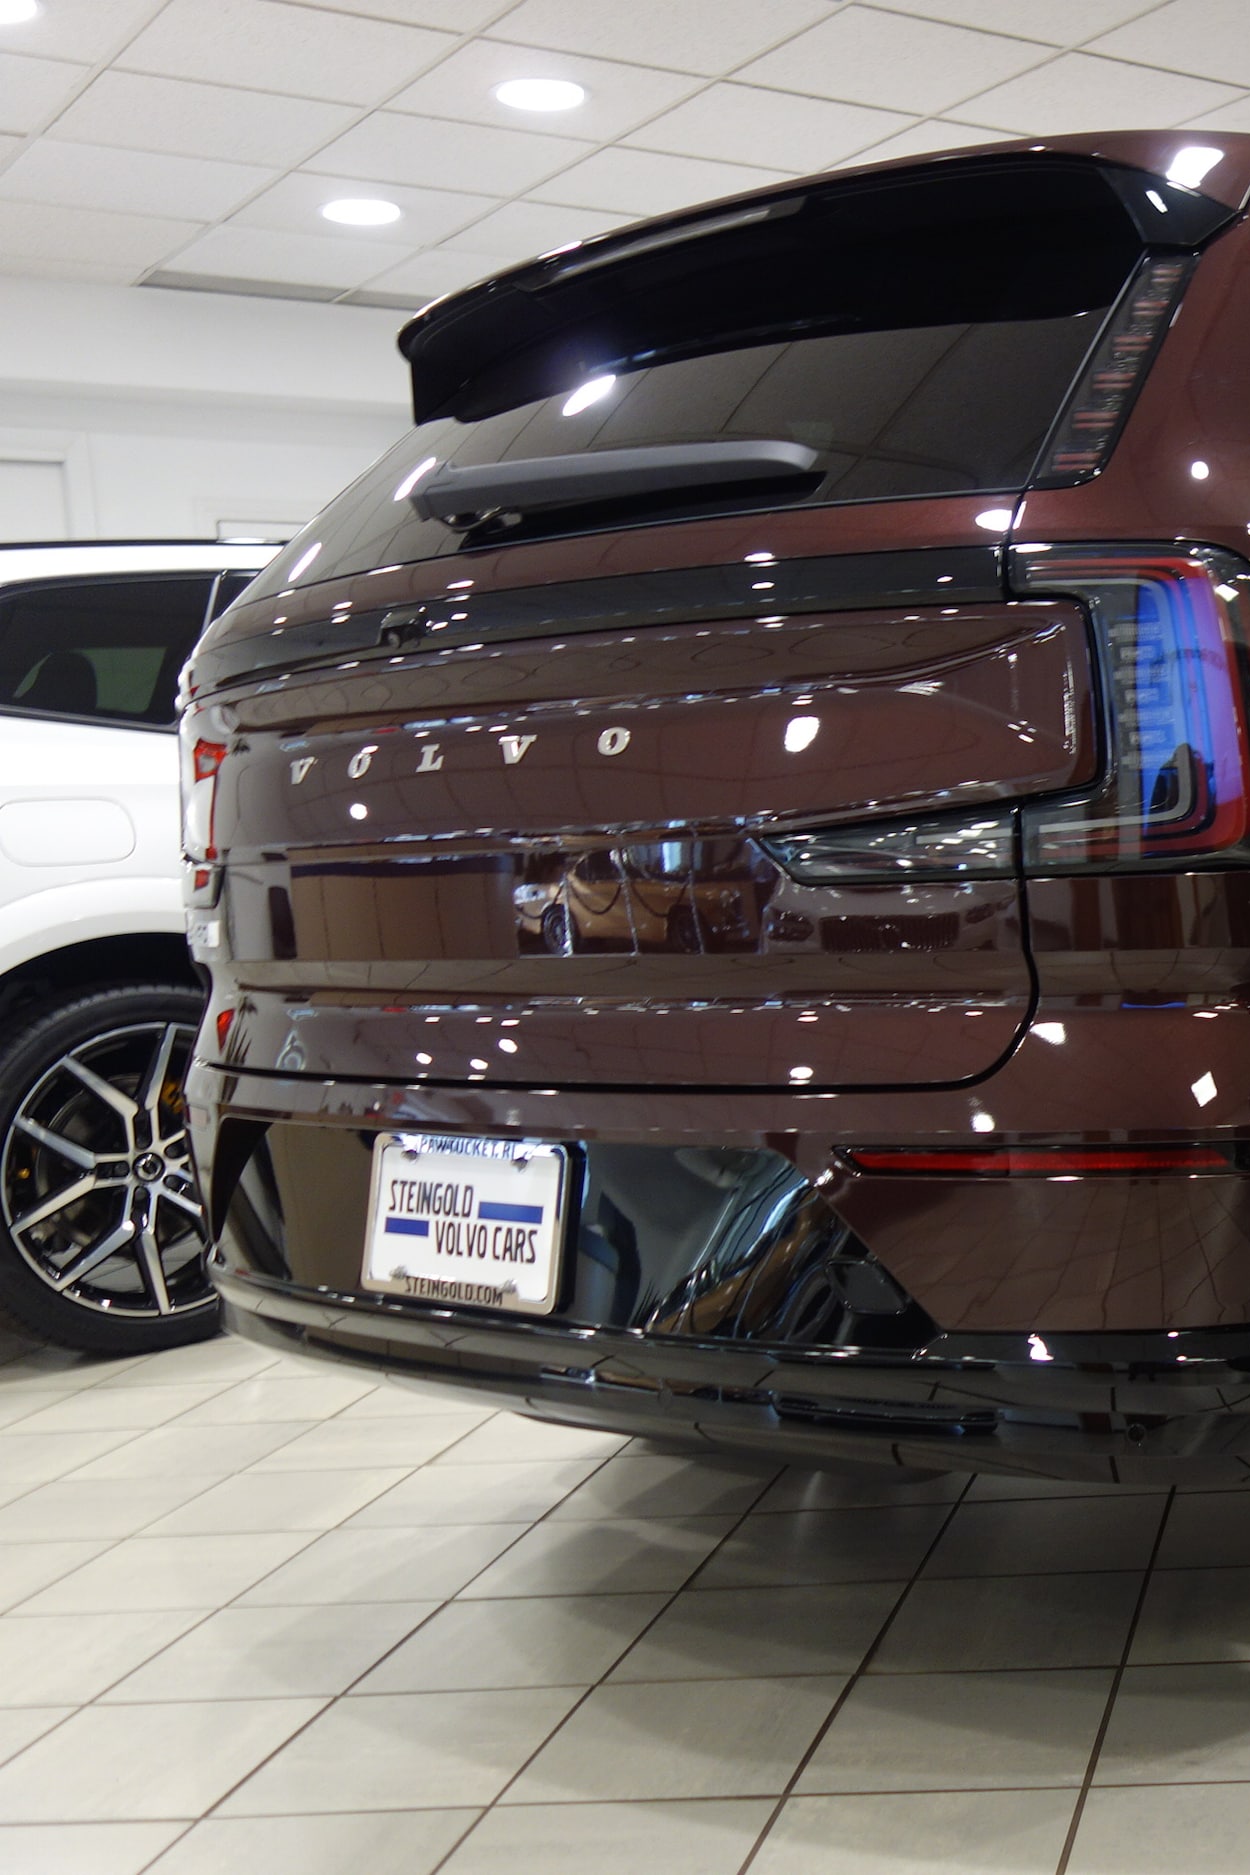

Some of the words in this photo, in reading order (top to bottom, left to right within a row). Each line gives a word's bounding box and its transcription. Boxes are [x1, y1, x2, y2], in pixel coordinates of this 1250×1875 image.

[290, 727, 631, 784] VOLVO
[389, 1179, 474, 1218] STEINGOLD
[435, 1220, 488, 1259] VOLVO
[493, 1225, 538, 1264] CARS
[405, 1276, 503, 1306] STEINGOLD.COM
